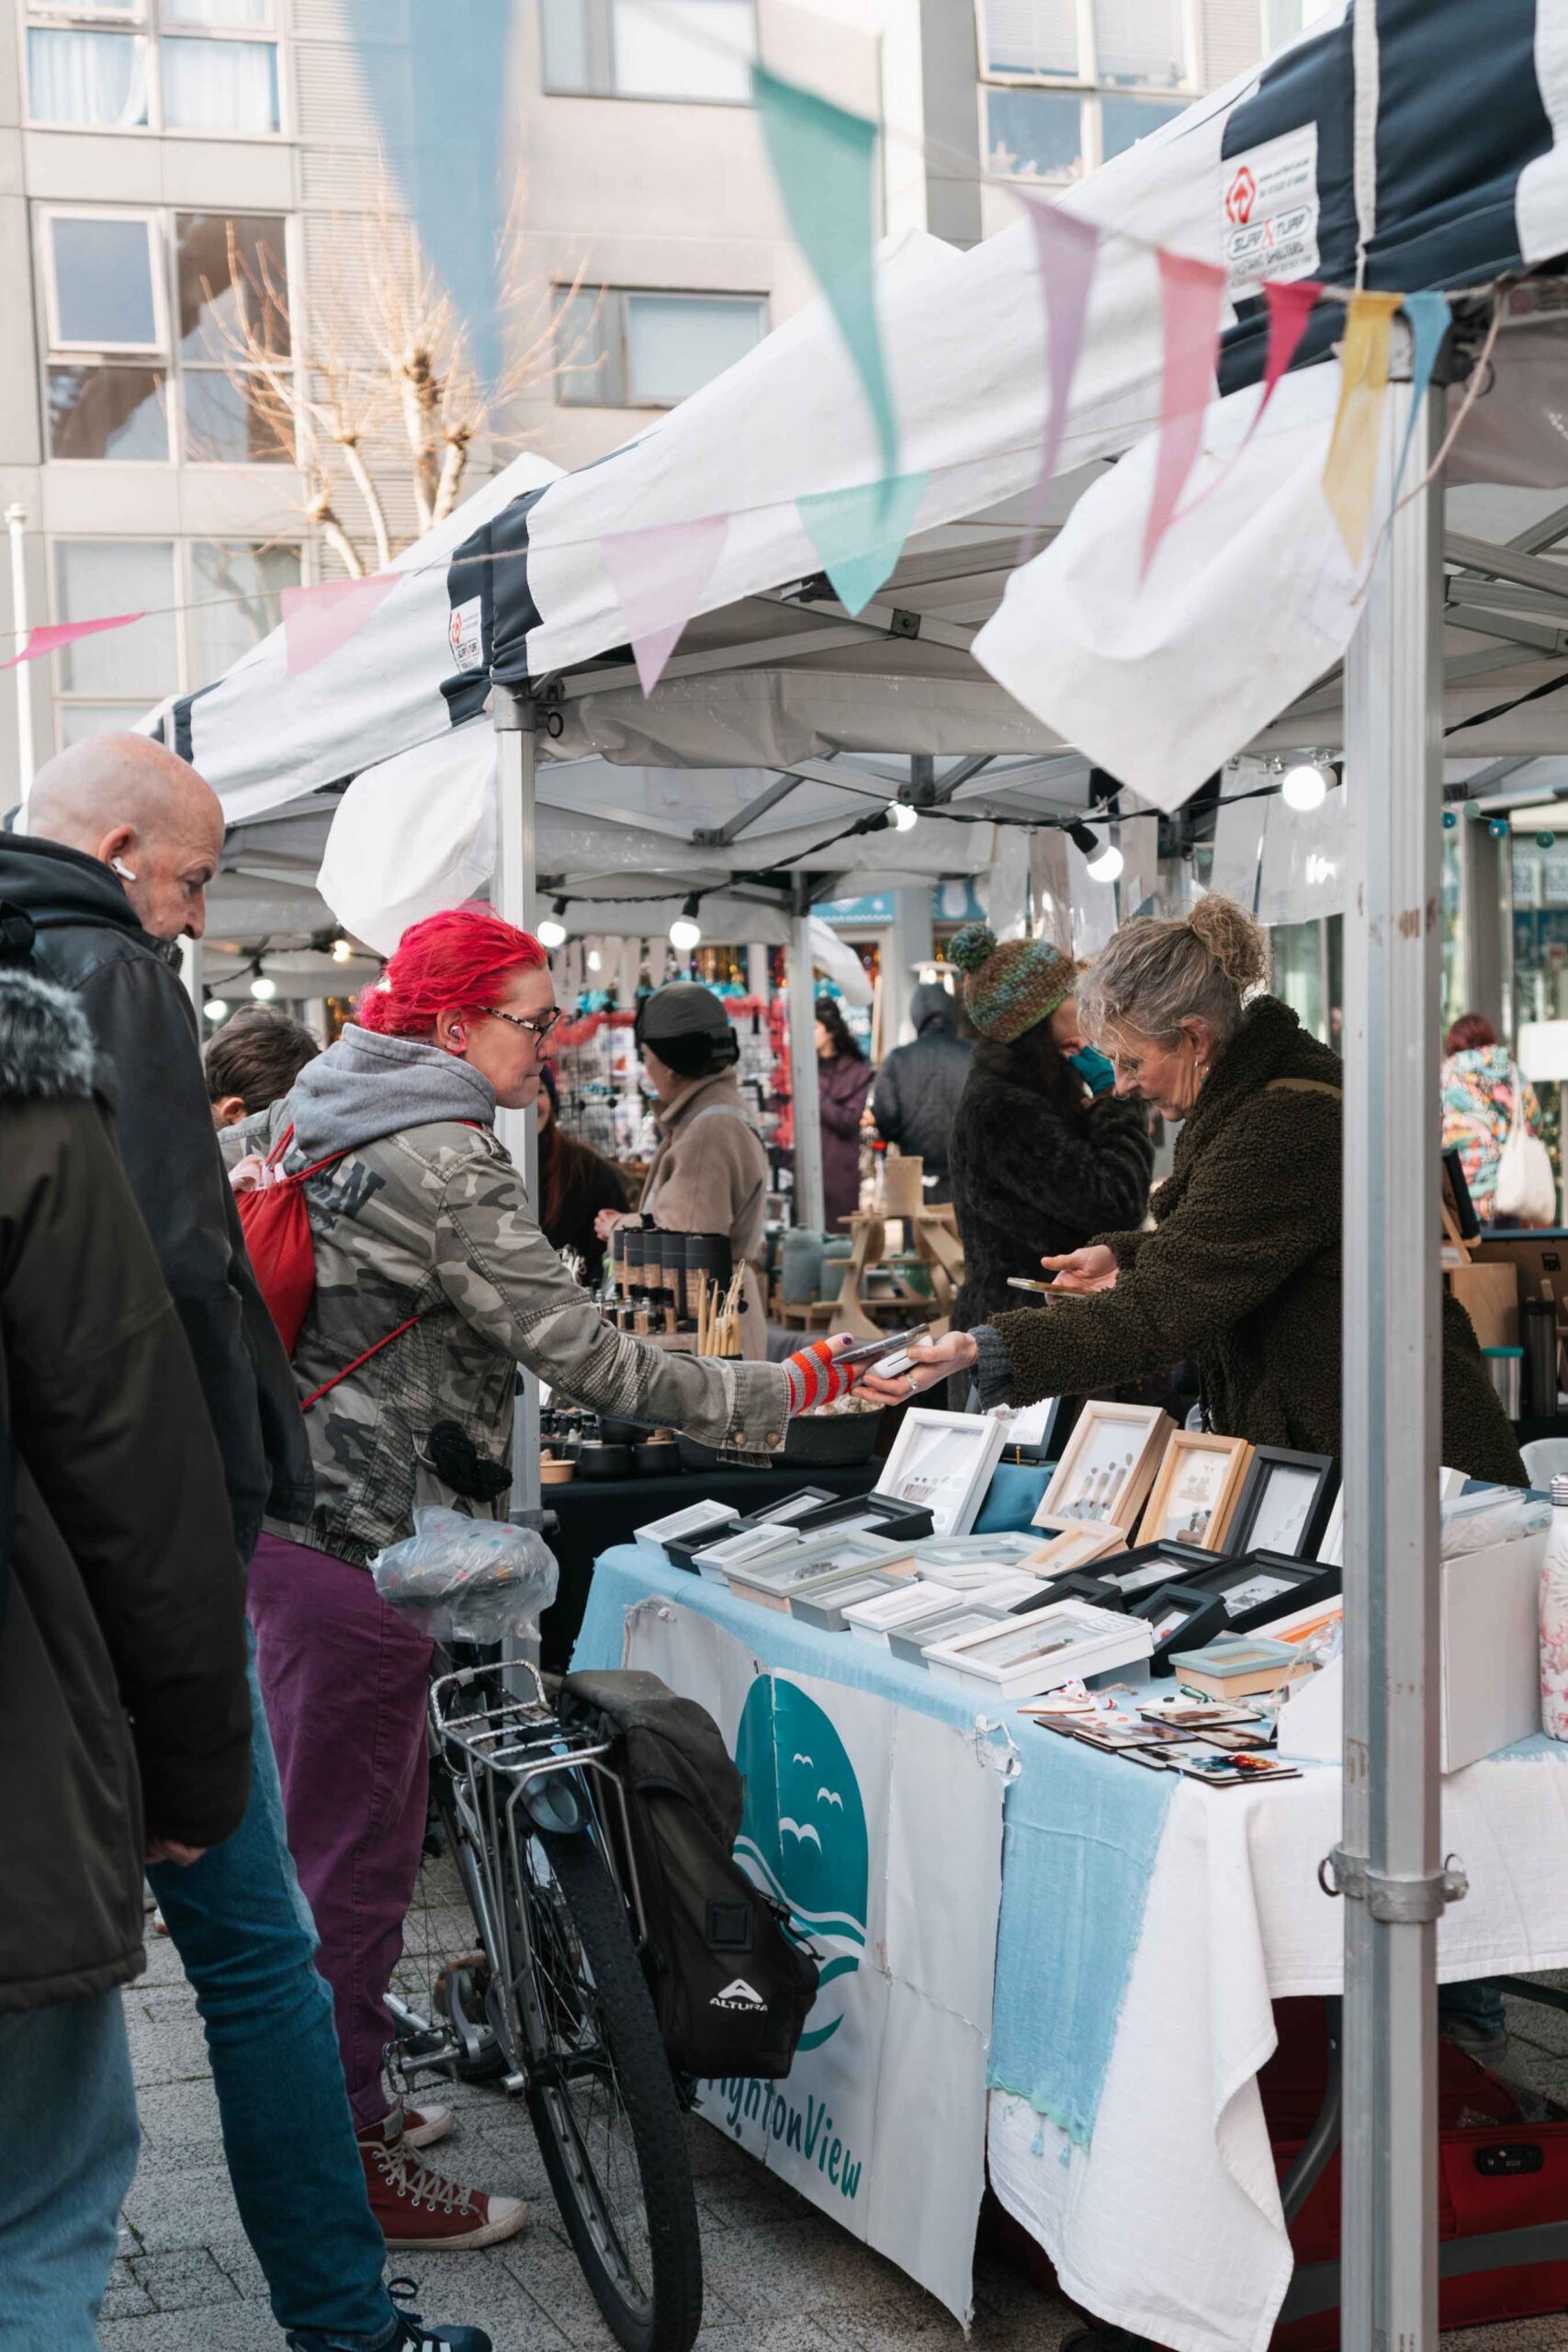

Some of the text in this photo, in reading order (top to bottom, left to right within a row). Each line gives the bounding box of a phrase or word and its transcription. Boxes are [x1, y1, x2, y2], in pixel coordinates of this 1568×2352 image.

[1261, 217, 1276, 250] &
[1277, 213, 1305, 237] TURF
[709, 1996, 768, 2012] ALTURA
